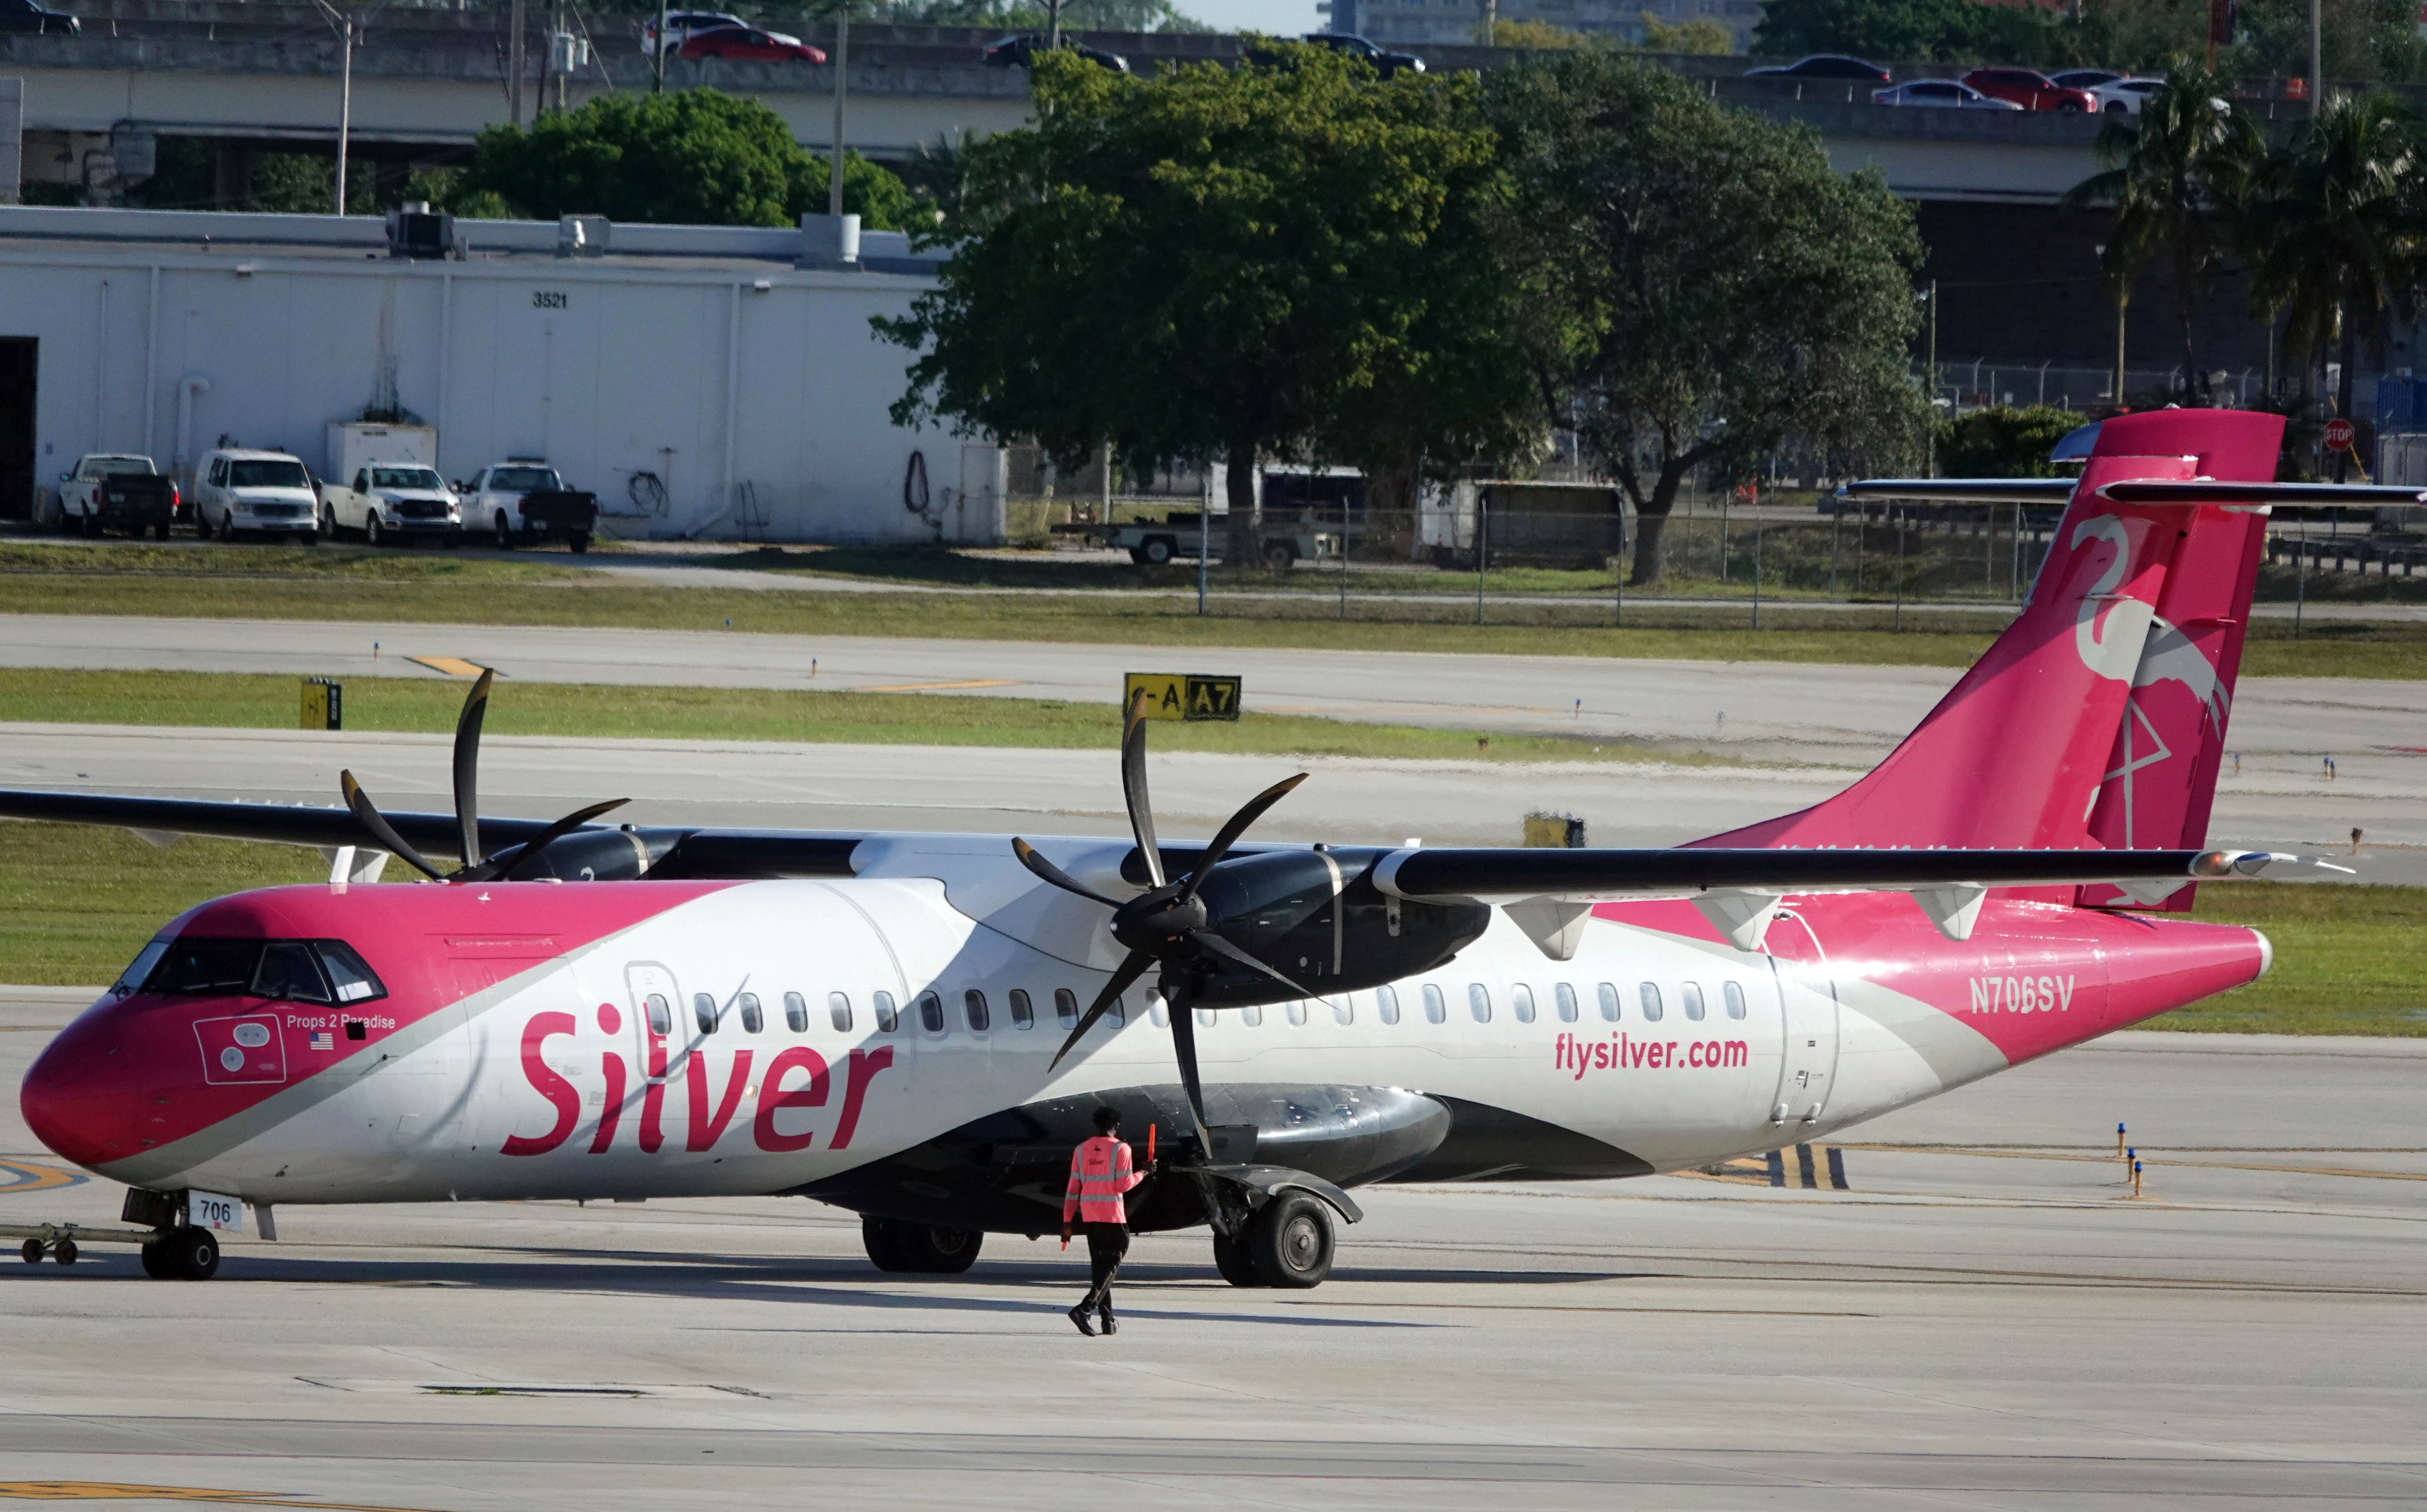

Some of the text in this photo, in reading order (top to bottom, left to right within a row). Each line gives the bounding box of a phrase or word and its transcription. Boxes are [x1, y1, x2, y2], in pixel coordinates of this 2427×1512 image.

[533, 291, 566, 308] 3521
[2325, 428, 2352, 442] STOP
[1162, 683, 1180, 712] A
[1194, 684, 1232, 711] A7
[1970, 975, 2075, 1014] N706SV
[287, 1015, 326, 1031] Props
[329, 1014, 337, 1028] 2
[1556, 1031, 1748, 1081] flysilver.com
[500, 1002, 894, 1157] Silver
[201, 1200, 231, 1223] 706
